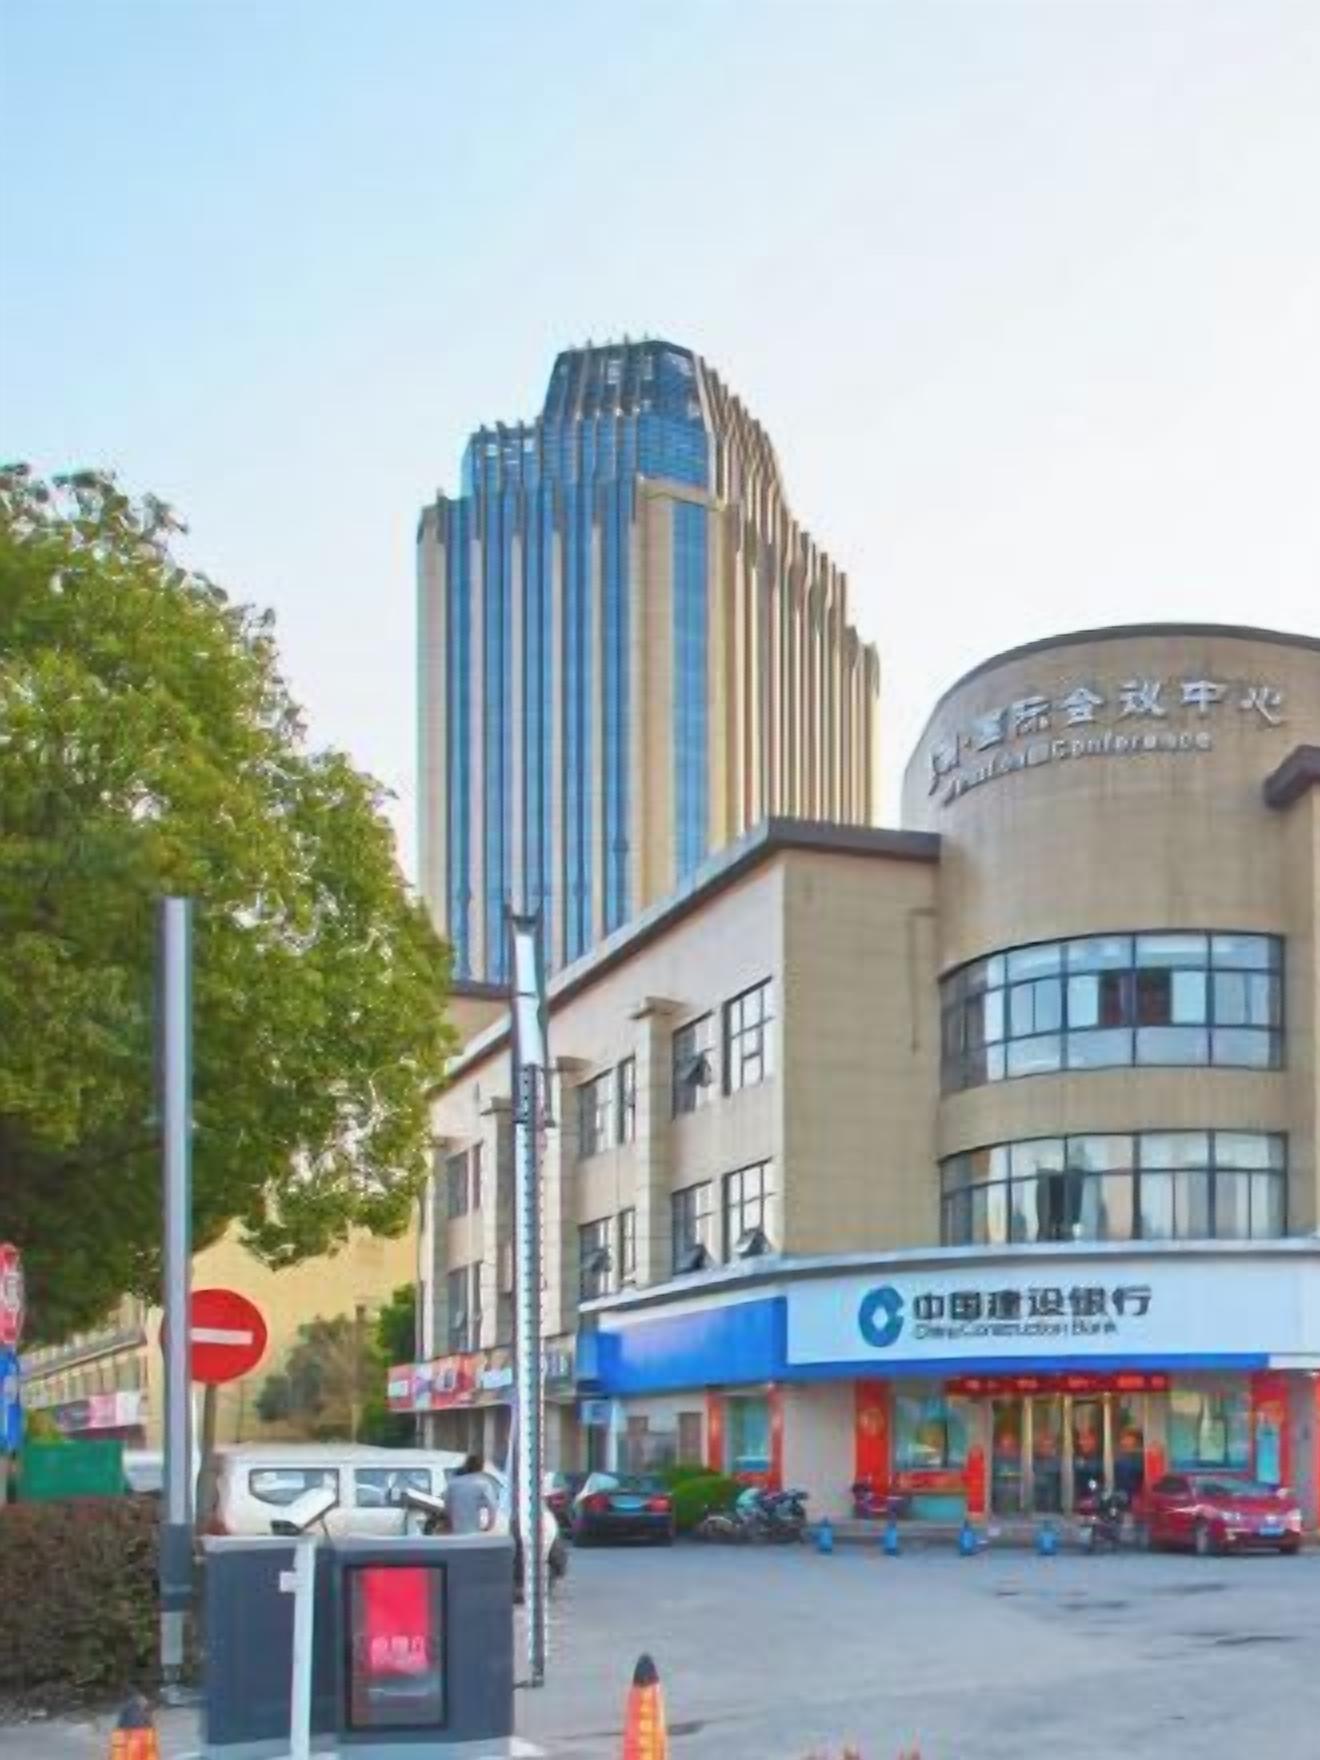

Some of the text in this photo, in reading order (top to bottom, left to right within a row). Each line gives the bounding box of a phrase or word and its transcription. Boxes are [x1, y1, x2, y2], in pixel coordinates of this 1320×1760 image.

[912, 1286, 1153, 1321] 中国建设银行
